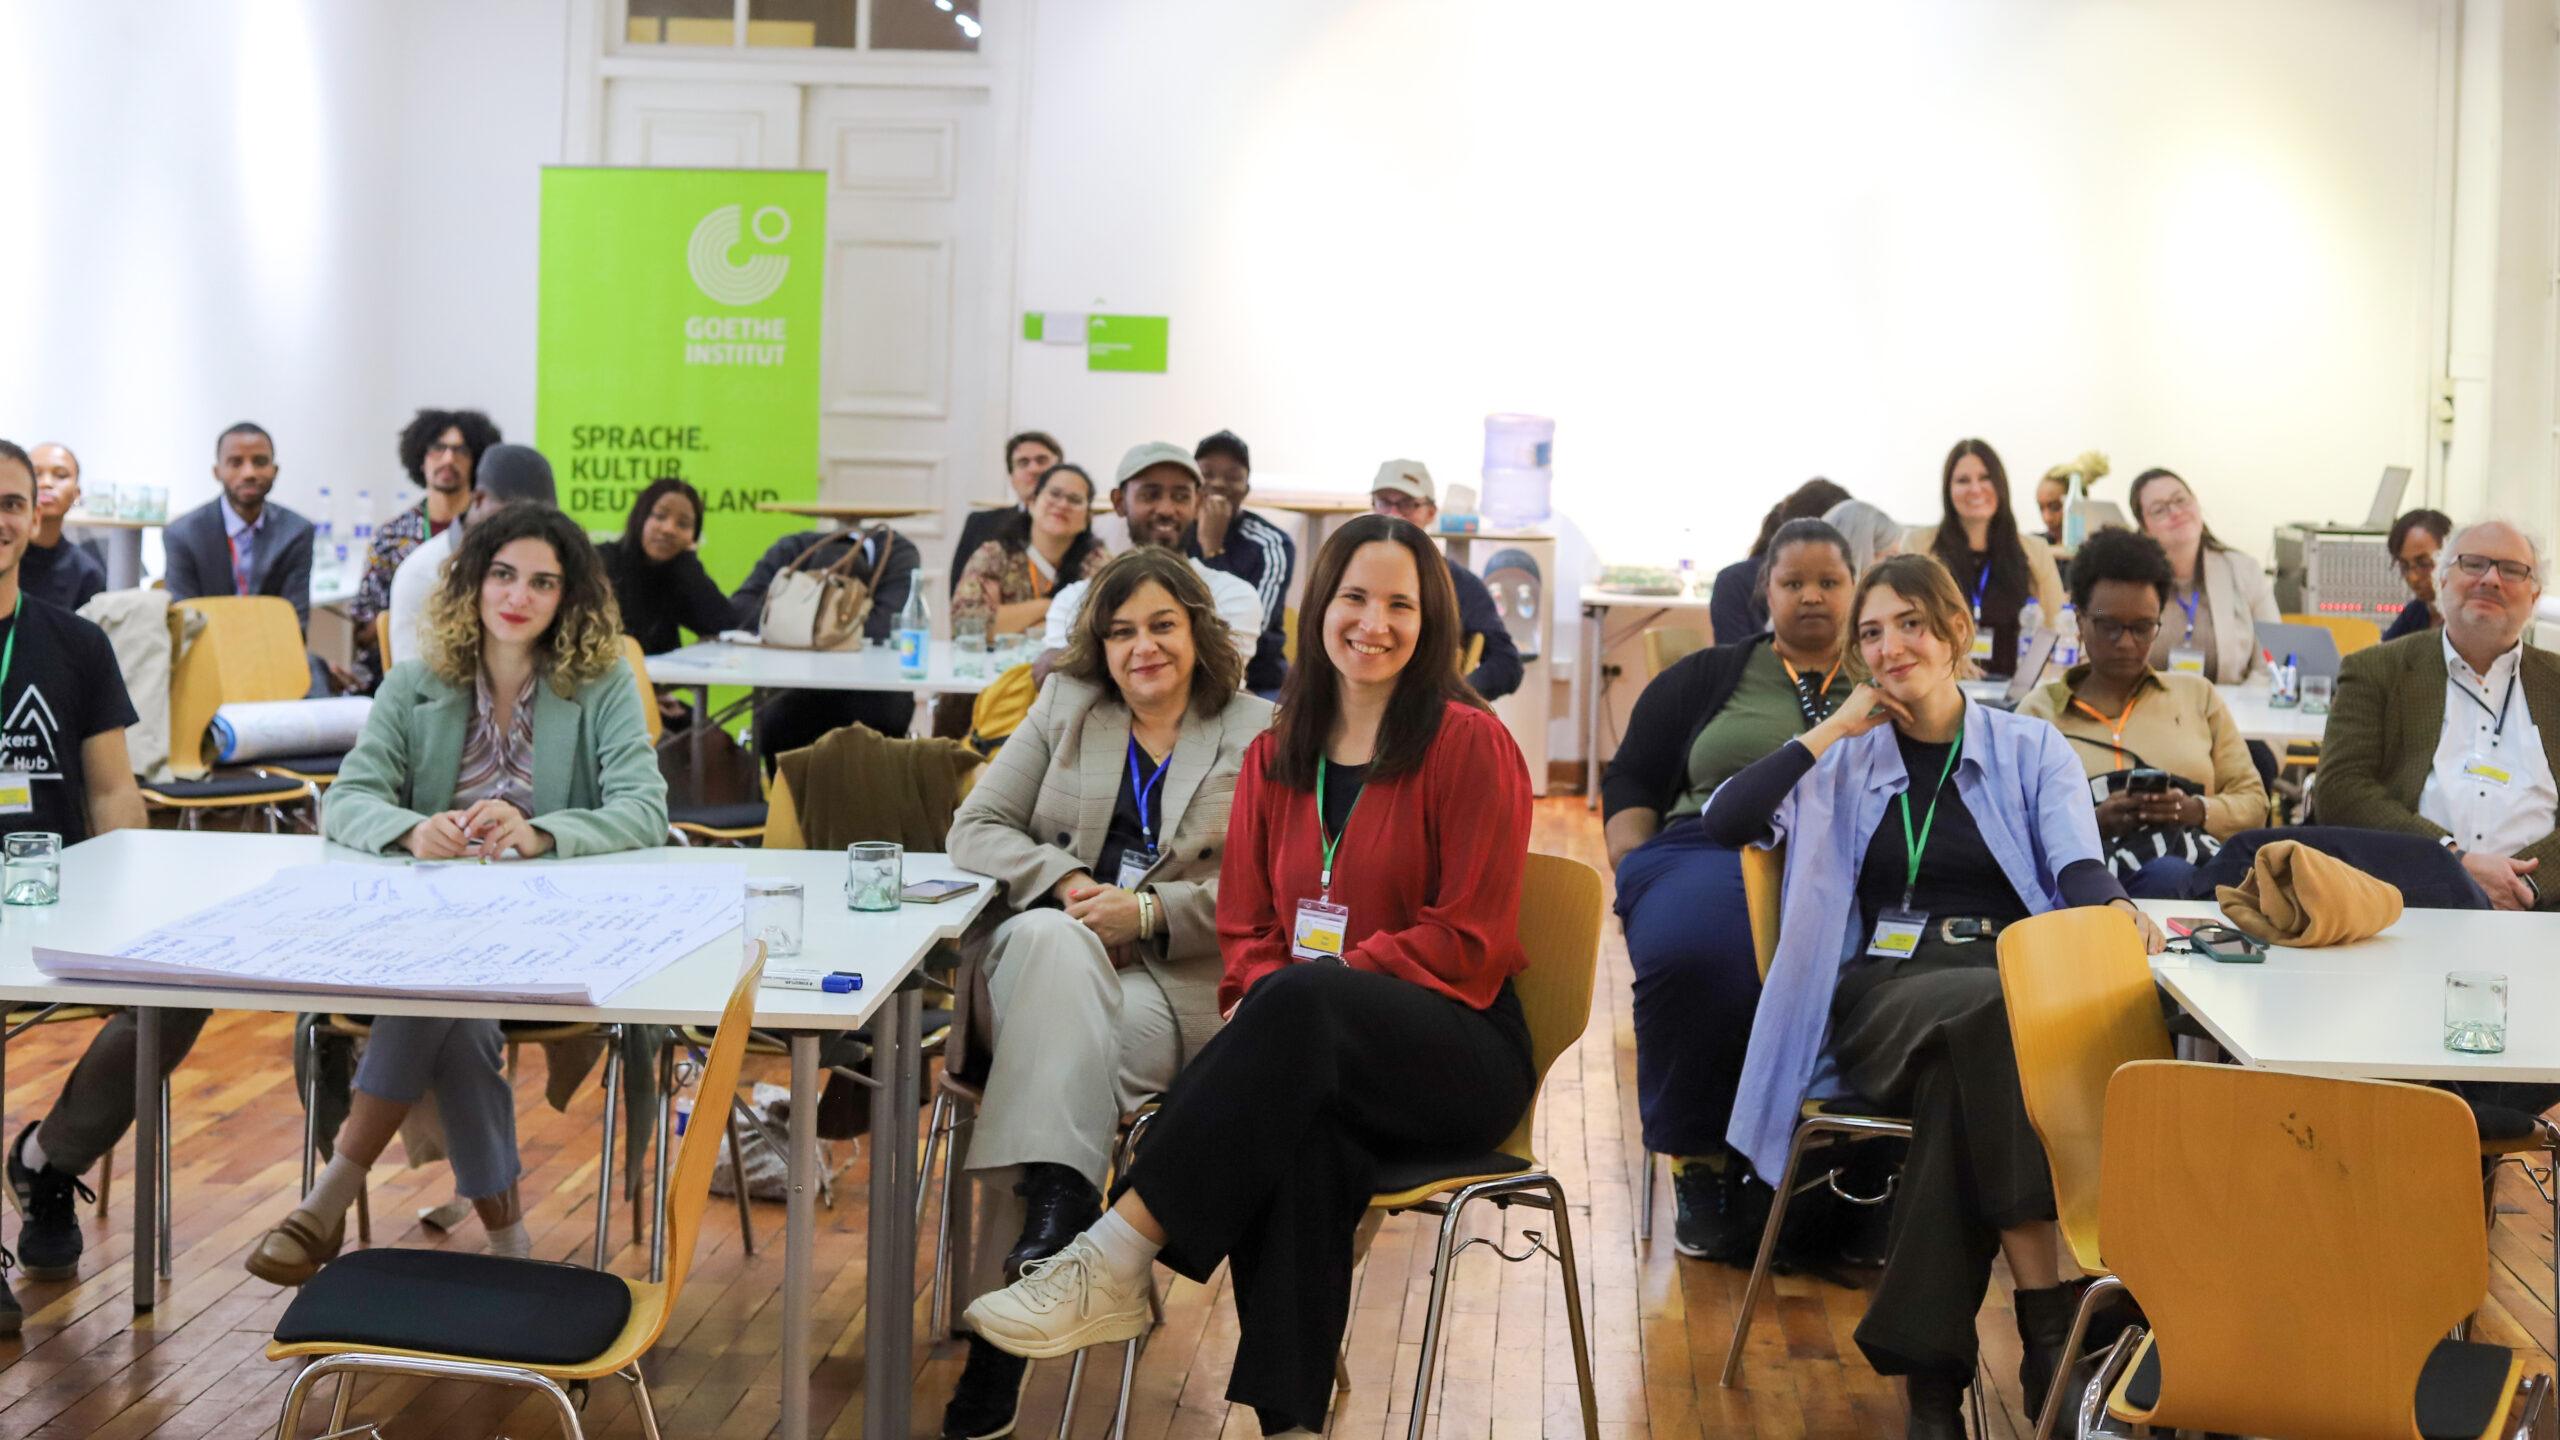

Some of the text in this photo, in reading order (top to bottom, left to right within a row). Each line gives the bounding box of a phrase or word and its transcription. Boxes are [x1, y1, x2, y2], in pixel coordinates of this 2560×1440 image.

[685, 315, 787, 341] GOETHE
[685, 343, 786, 367] INSTITUT
[571, 425, 710, 452] SPRACHE.
[13, 755, 50, 771] Hub
